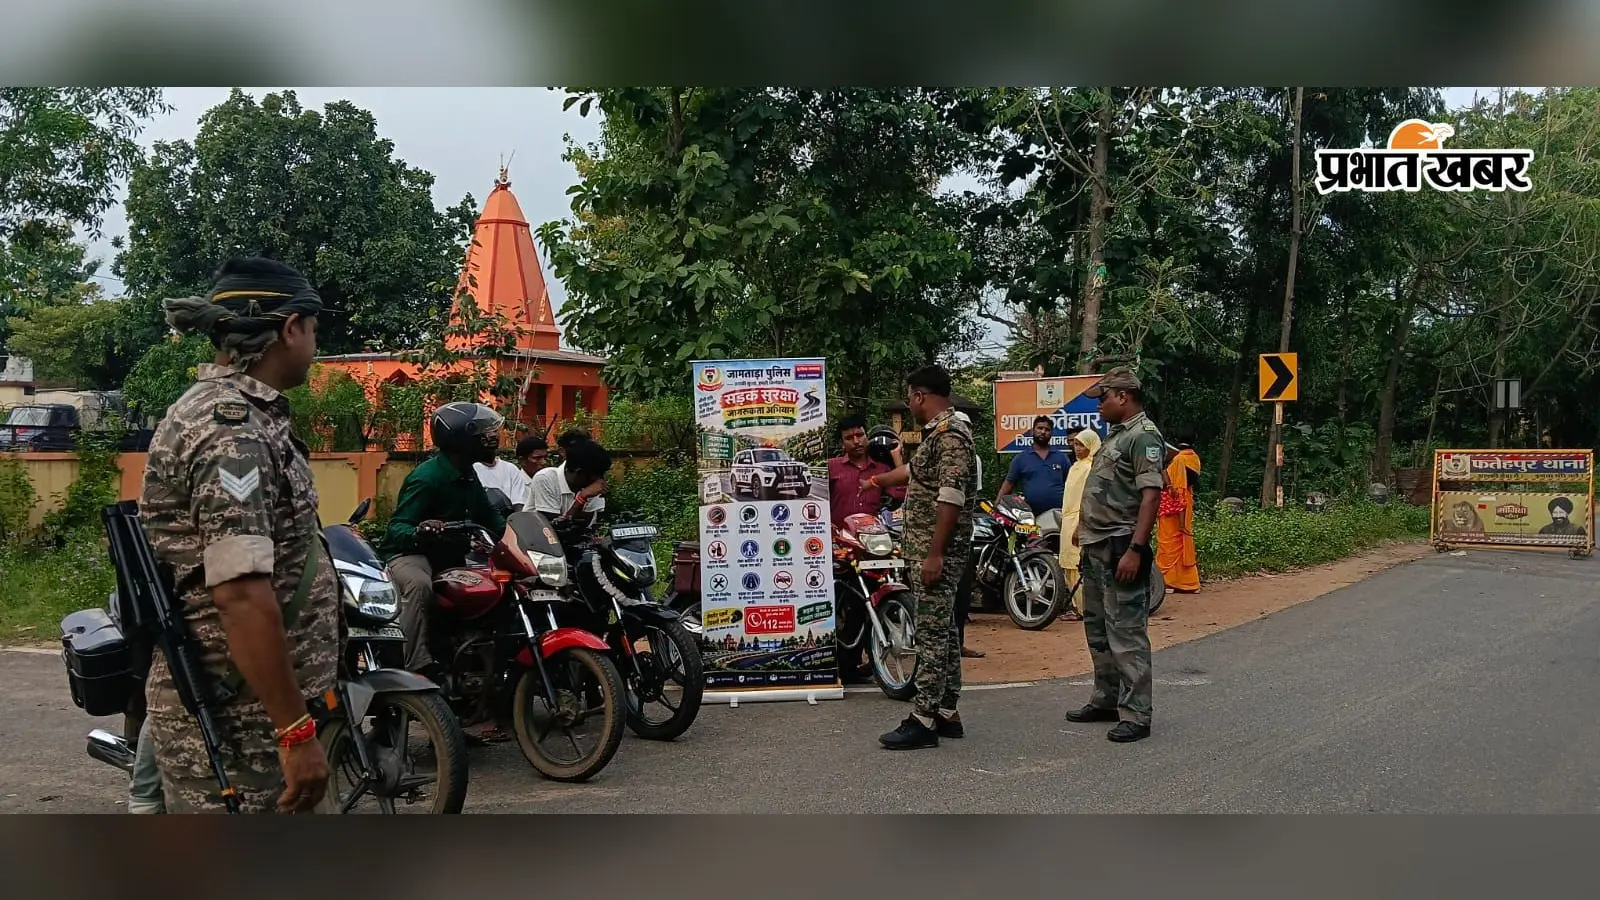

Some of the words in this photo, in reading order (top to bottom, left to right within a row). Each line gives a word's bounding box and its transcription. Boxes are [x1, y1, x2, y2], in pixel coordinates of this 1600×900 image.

[727, 369, 763, 379] जामताड़ा
[766, 366, 791, 380] पुलिस
[724, 390, 758, 405] सड़क
[760, 388, 797, 404] सुरक्षा
[727, 407, 765, 417] जागरूकता
[766, 404, 794, 414] अभियान
[1015, 434, 1034, 446] जिल
[1472, 457, 1537, 472] फतेहपुर
[1543, 459, 1585, 470] थाना
[762, 619, 778, 630] 112
